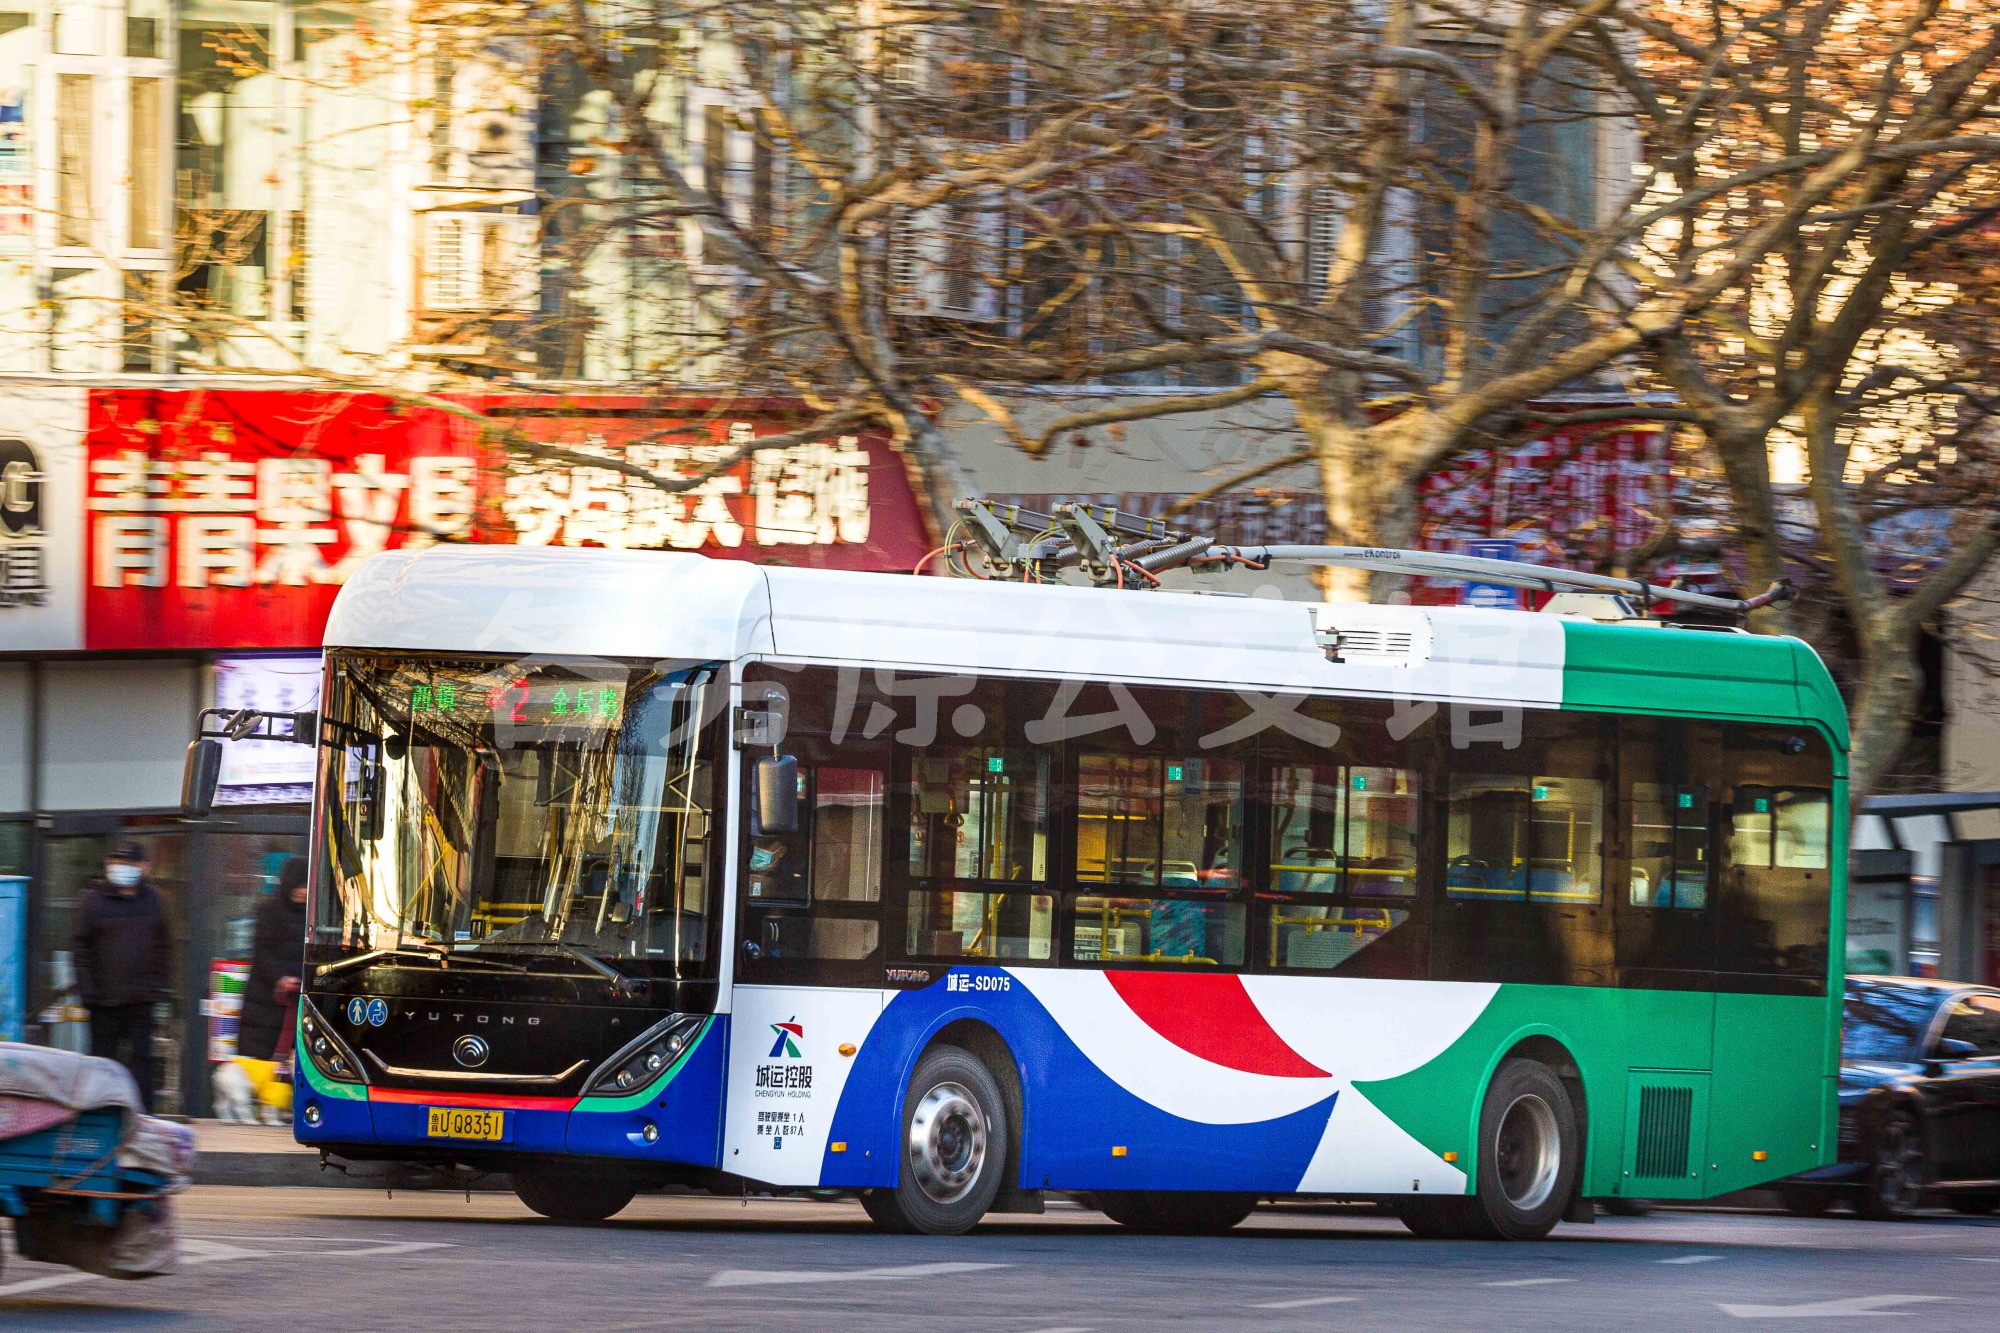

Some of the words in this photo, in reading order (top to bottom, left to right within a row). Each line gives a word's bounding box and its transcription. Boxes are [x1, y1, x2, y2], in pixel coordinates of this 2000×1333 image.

[886, 969, 930, 981] YUTONG
[946, 973, 1011, 992] 城运-SD075
[404, 1011, 540, 1026] YUTONG
[755, 1064, 813, 1089] 城运控股
[754, 1089, 785, 1098] CHENGYUN
[787, 1090, 812, 1099] HOLDING
